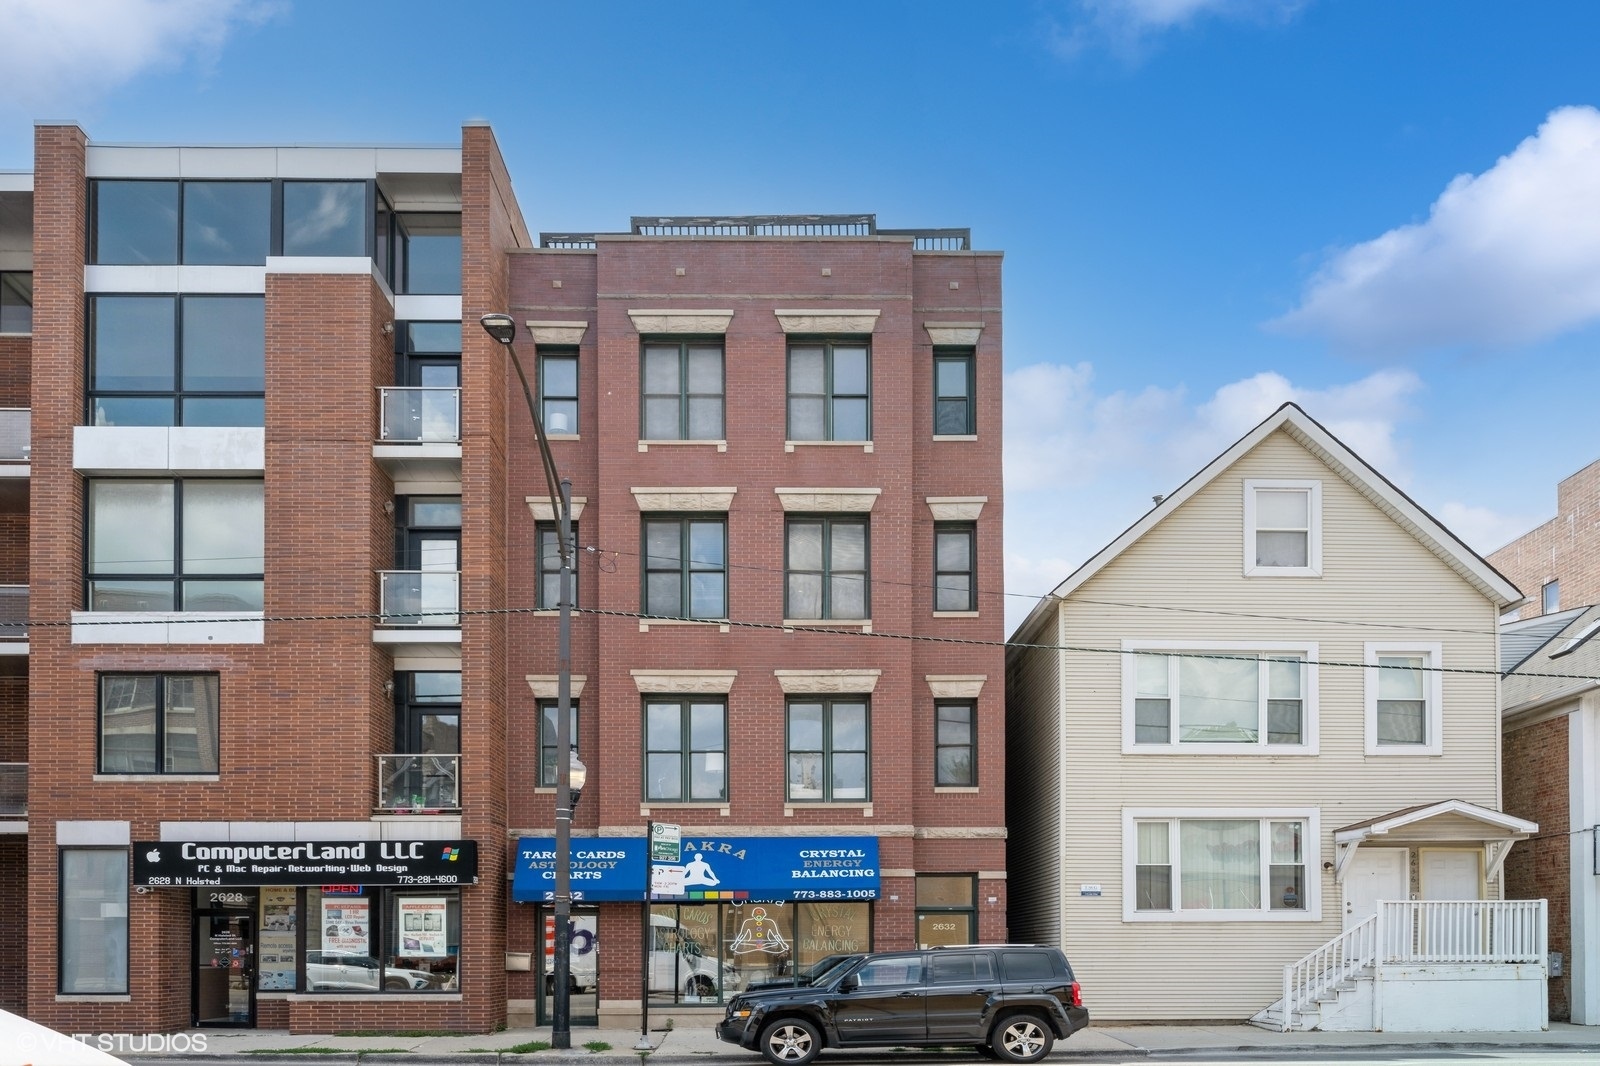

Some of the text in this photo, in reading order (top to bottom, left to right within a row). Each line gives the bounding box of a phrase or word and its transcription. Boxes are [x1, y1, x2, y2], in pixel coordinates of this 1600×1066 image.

[181, 841, 424, 864] ComputerLand LLC
[522, 851, 626, 859] TAR CARDS
[684, 841, 746, 860] AKRA
[799, 850, 865, 858] CRYSTAL
[803, 860, 862, 868] ENERGY
[252, 865, 282, 874] Repair
[288, 864, 346, 874] Networking
[376, 864, 408, 874] Design
[792, 869, 875, 878] BALANCING
[397, 875, 458, 884] 773-281-4600
[321, 884, 359, 893] OPEN
[210, 892, 243, 902] 2628
[545, 892, 582, 900] 22
[793, 890, 876, 898] 773-883-1005
[812, 924, 852, 937] ENERGY
[802, 938, 859, 952] BALANCING
